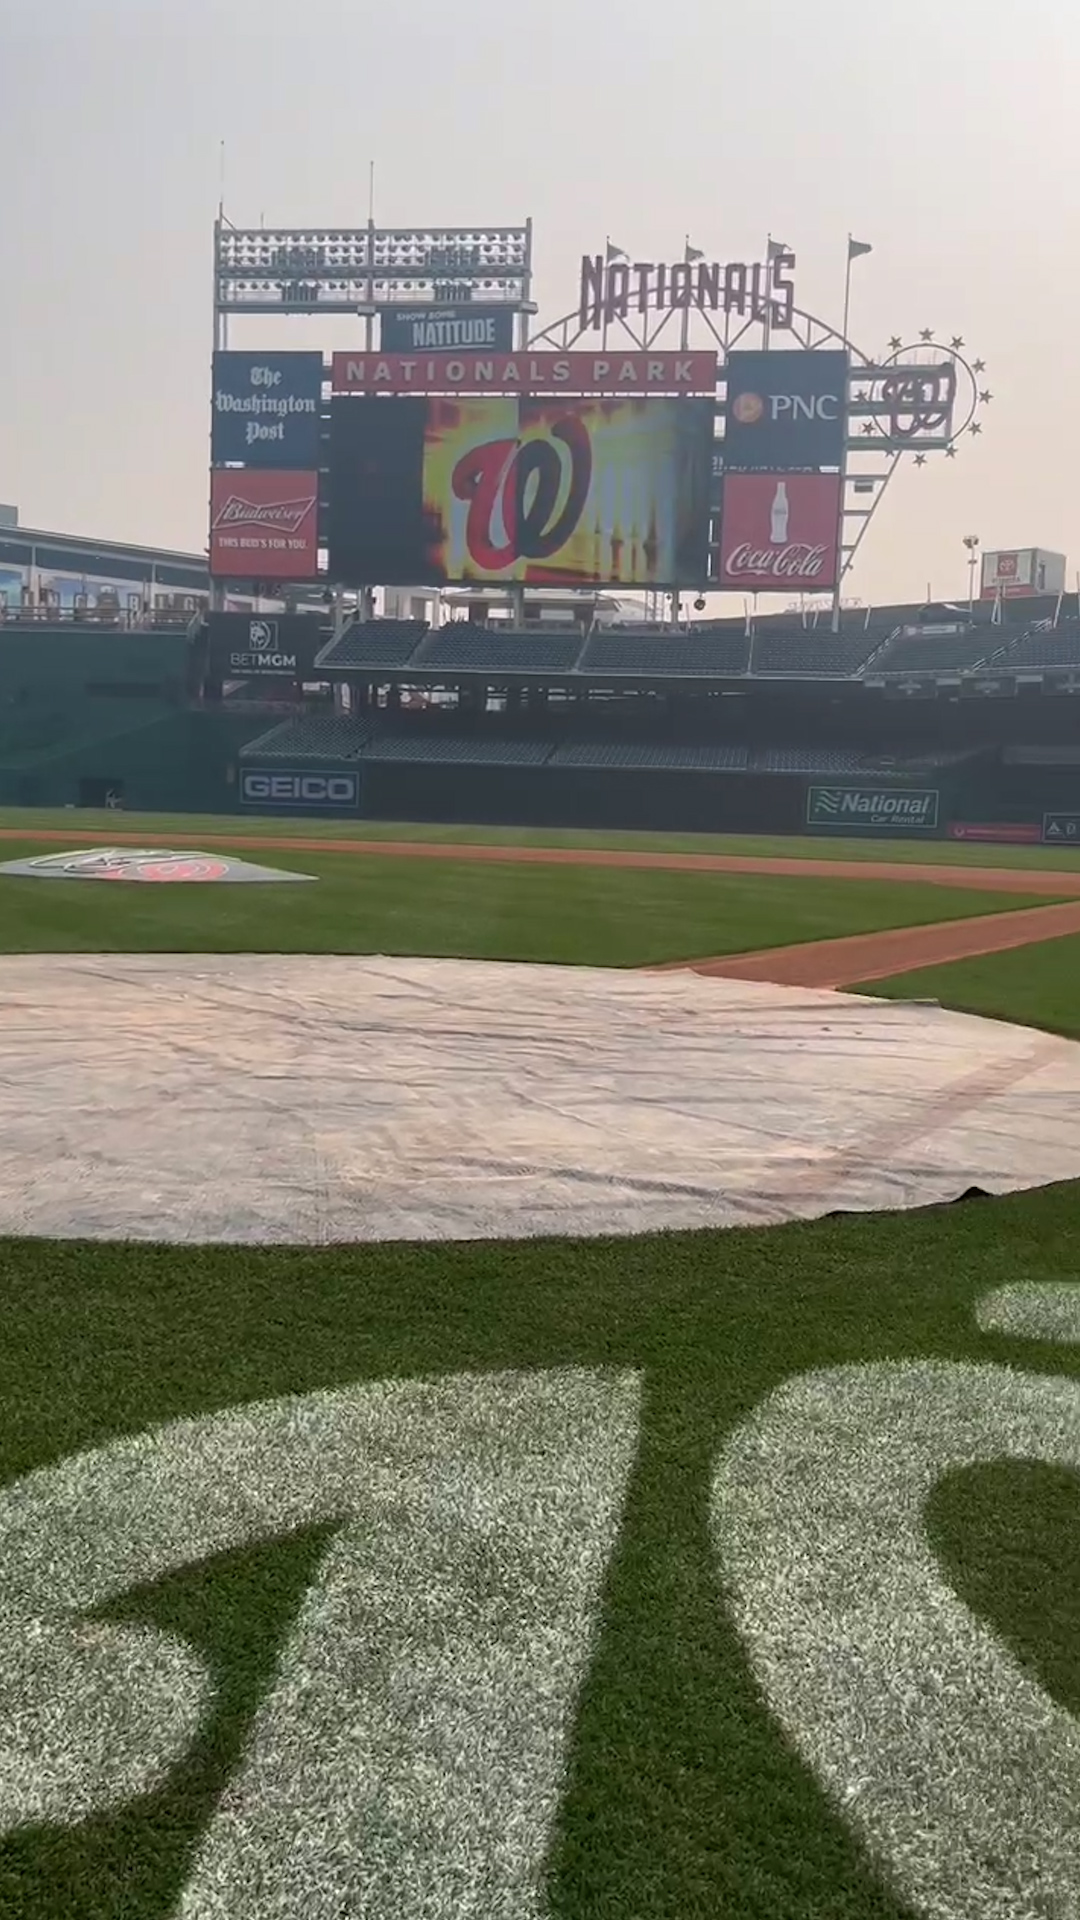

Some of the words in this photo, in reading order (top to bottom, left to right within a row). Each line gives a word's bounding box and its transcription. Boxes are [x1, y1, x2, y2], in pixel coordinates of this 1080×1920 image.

[579, 254, 796, 331] NATIONALS
[412, 318, 496, 347] NATITUDE
[250, 366, 282, 388] The
[346, 360, 571, 382] NATIONALS
[592, 360, 693, 382] PARK
[215, 389, 316, 417] Washington
[769, 395, 838, 421] PNC
[245, 421, 284, 445] Post
[222, 502, 304, 520] Budweiser
[219, 537, 238, 548] THIS
[269, 537, 287, 549] FOR
[230, 652, 296, 667] BETMGM
[244, 775, 355, 800] GEICO
[840, 793, 931, 814] National
[871, 814, 888, 823] Car
[890, 815, 925, 825] Rental
